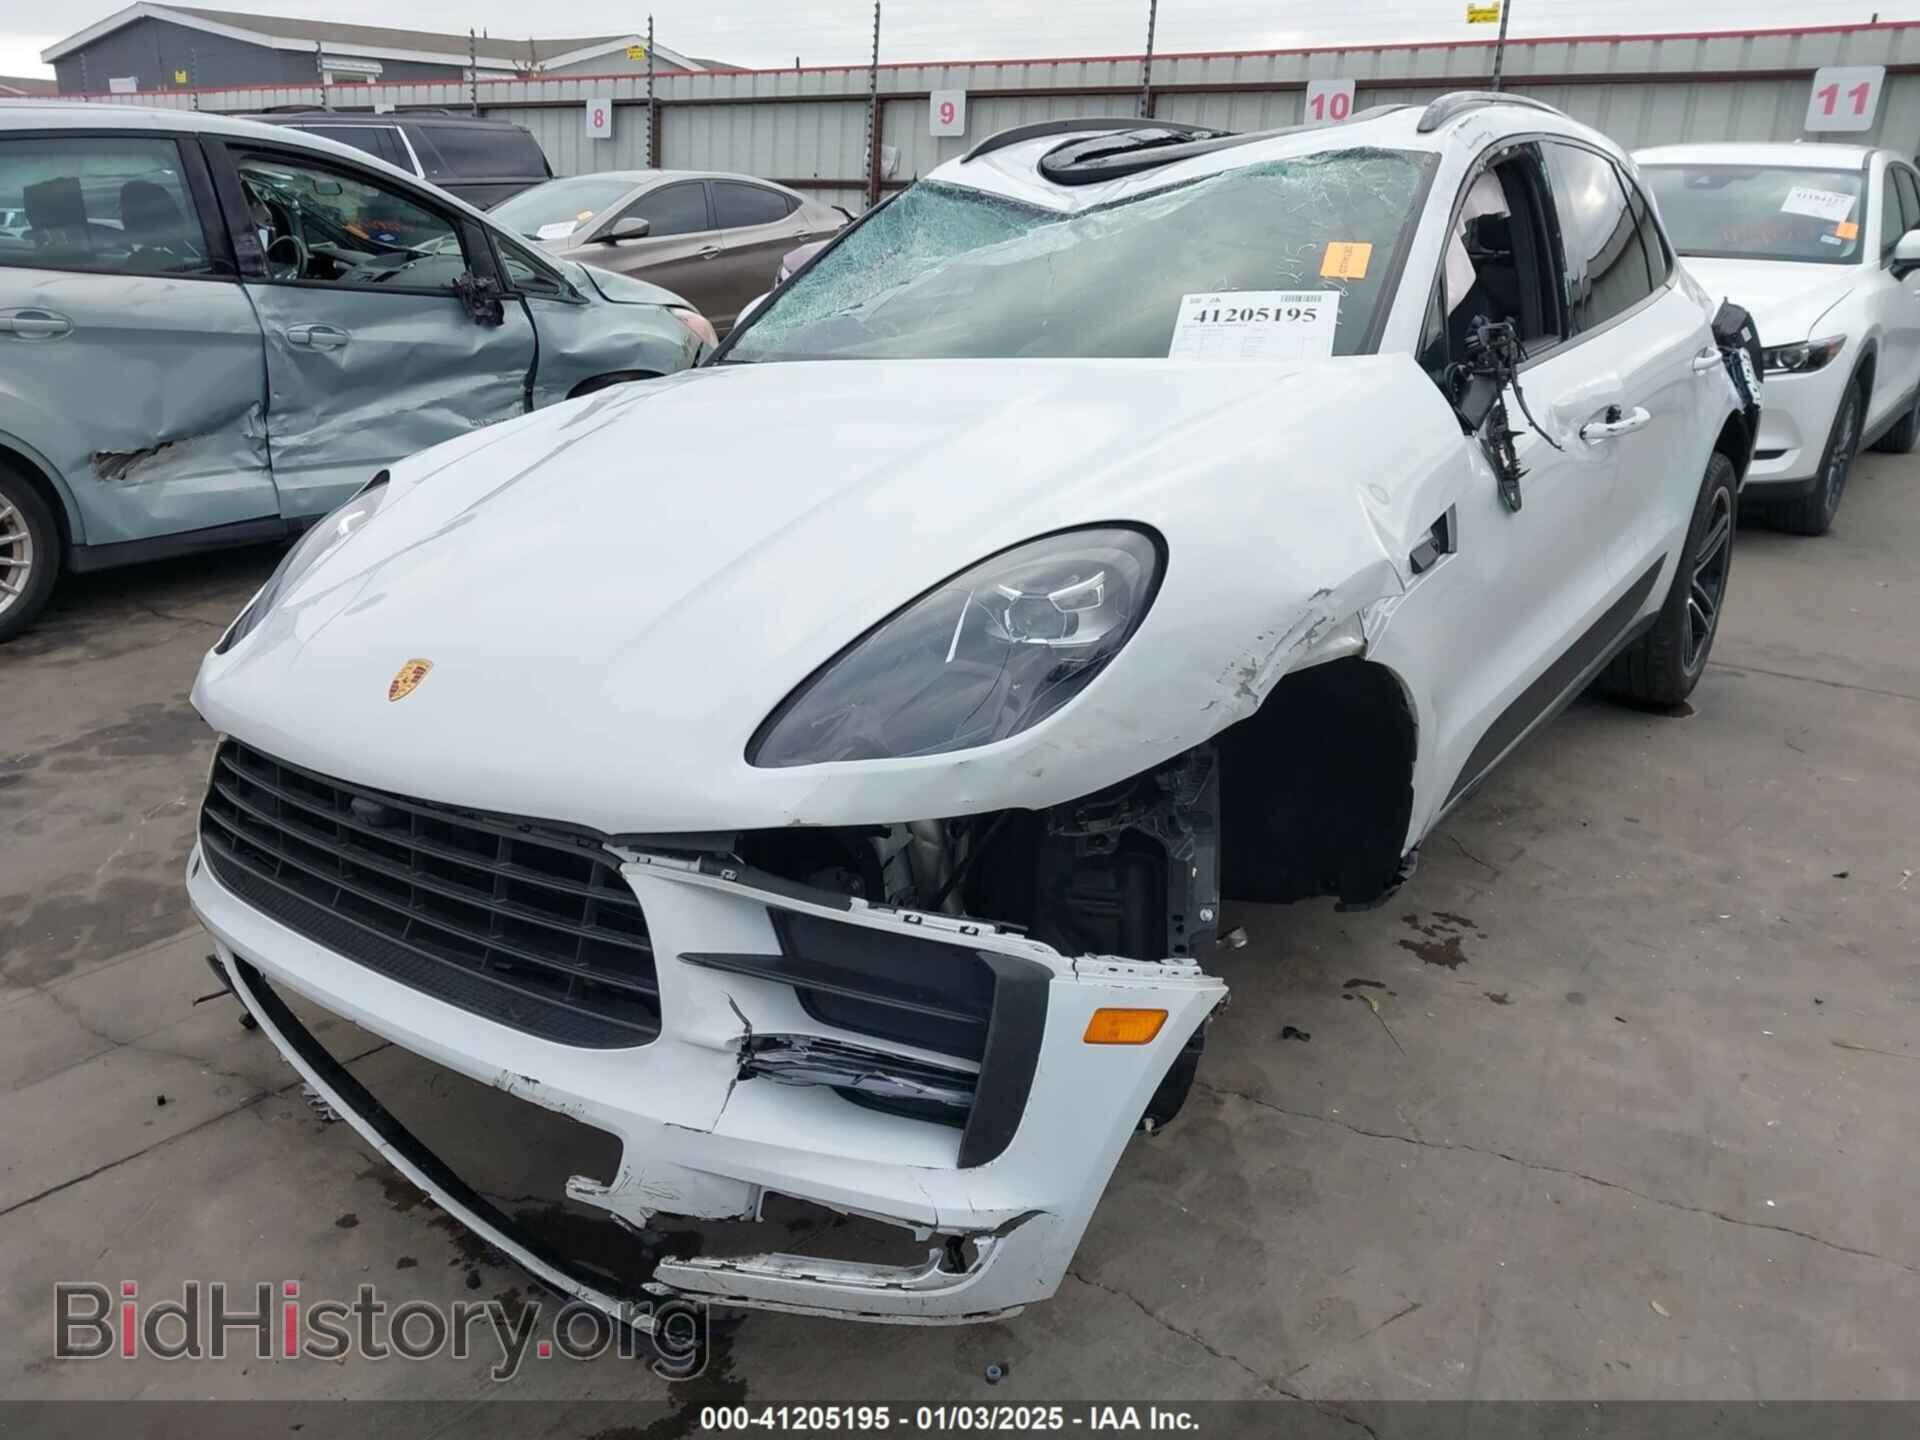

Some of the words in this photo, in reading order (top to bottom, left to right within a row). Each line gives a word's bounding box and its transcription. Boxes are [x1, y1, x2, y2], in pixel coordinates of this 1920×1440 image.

[1310, 93, 1350, 121] 10
[1817, 82, 1870, 115] 11
[594, 108, 604, 128] 8
[940, 102, 954, 124] 9
[1193, 307, 1318, 323] 41205195
